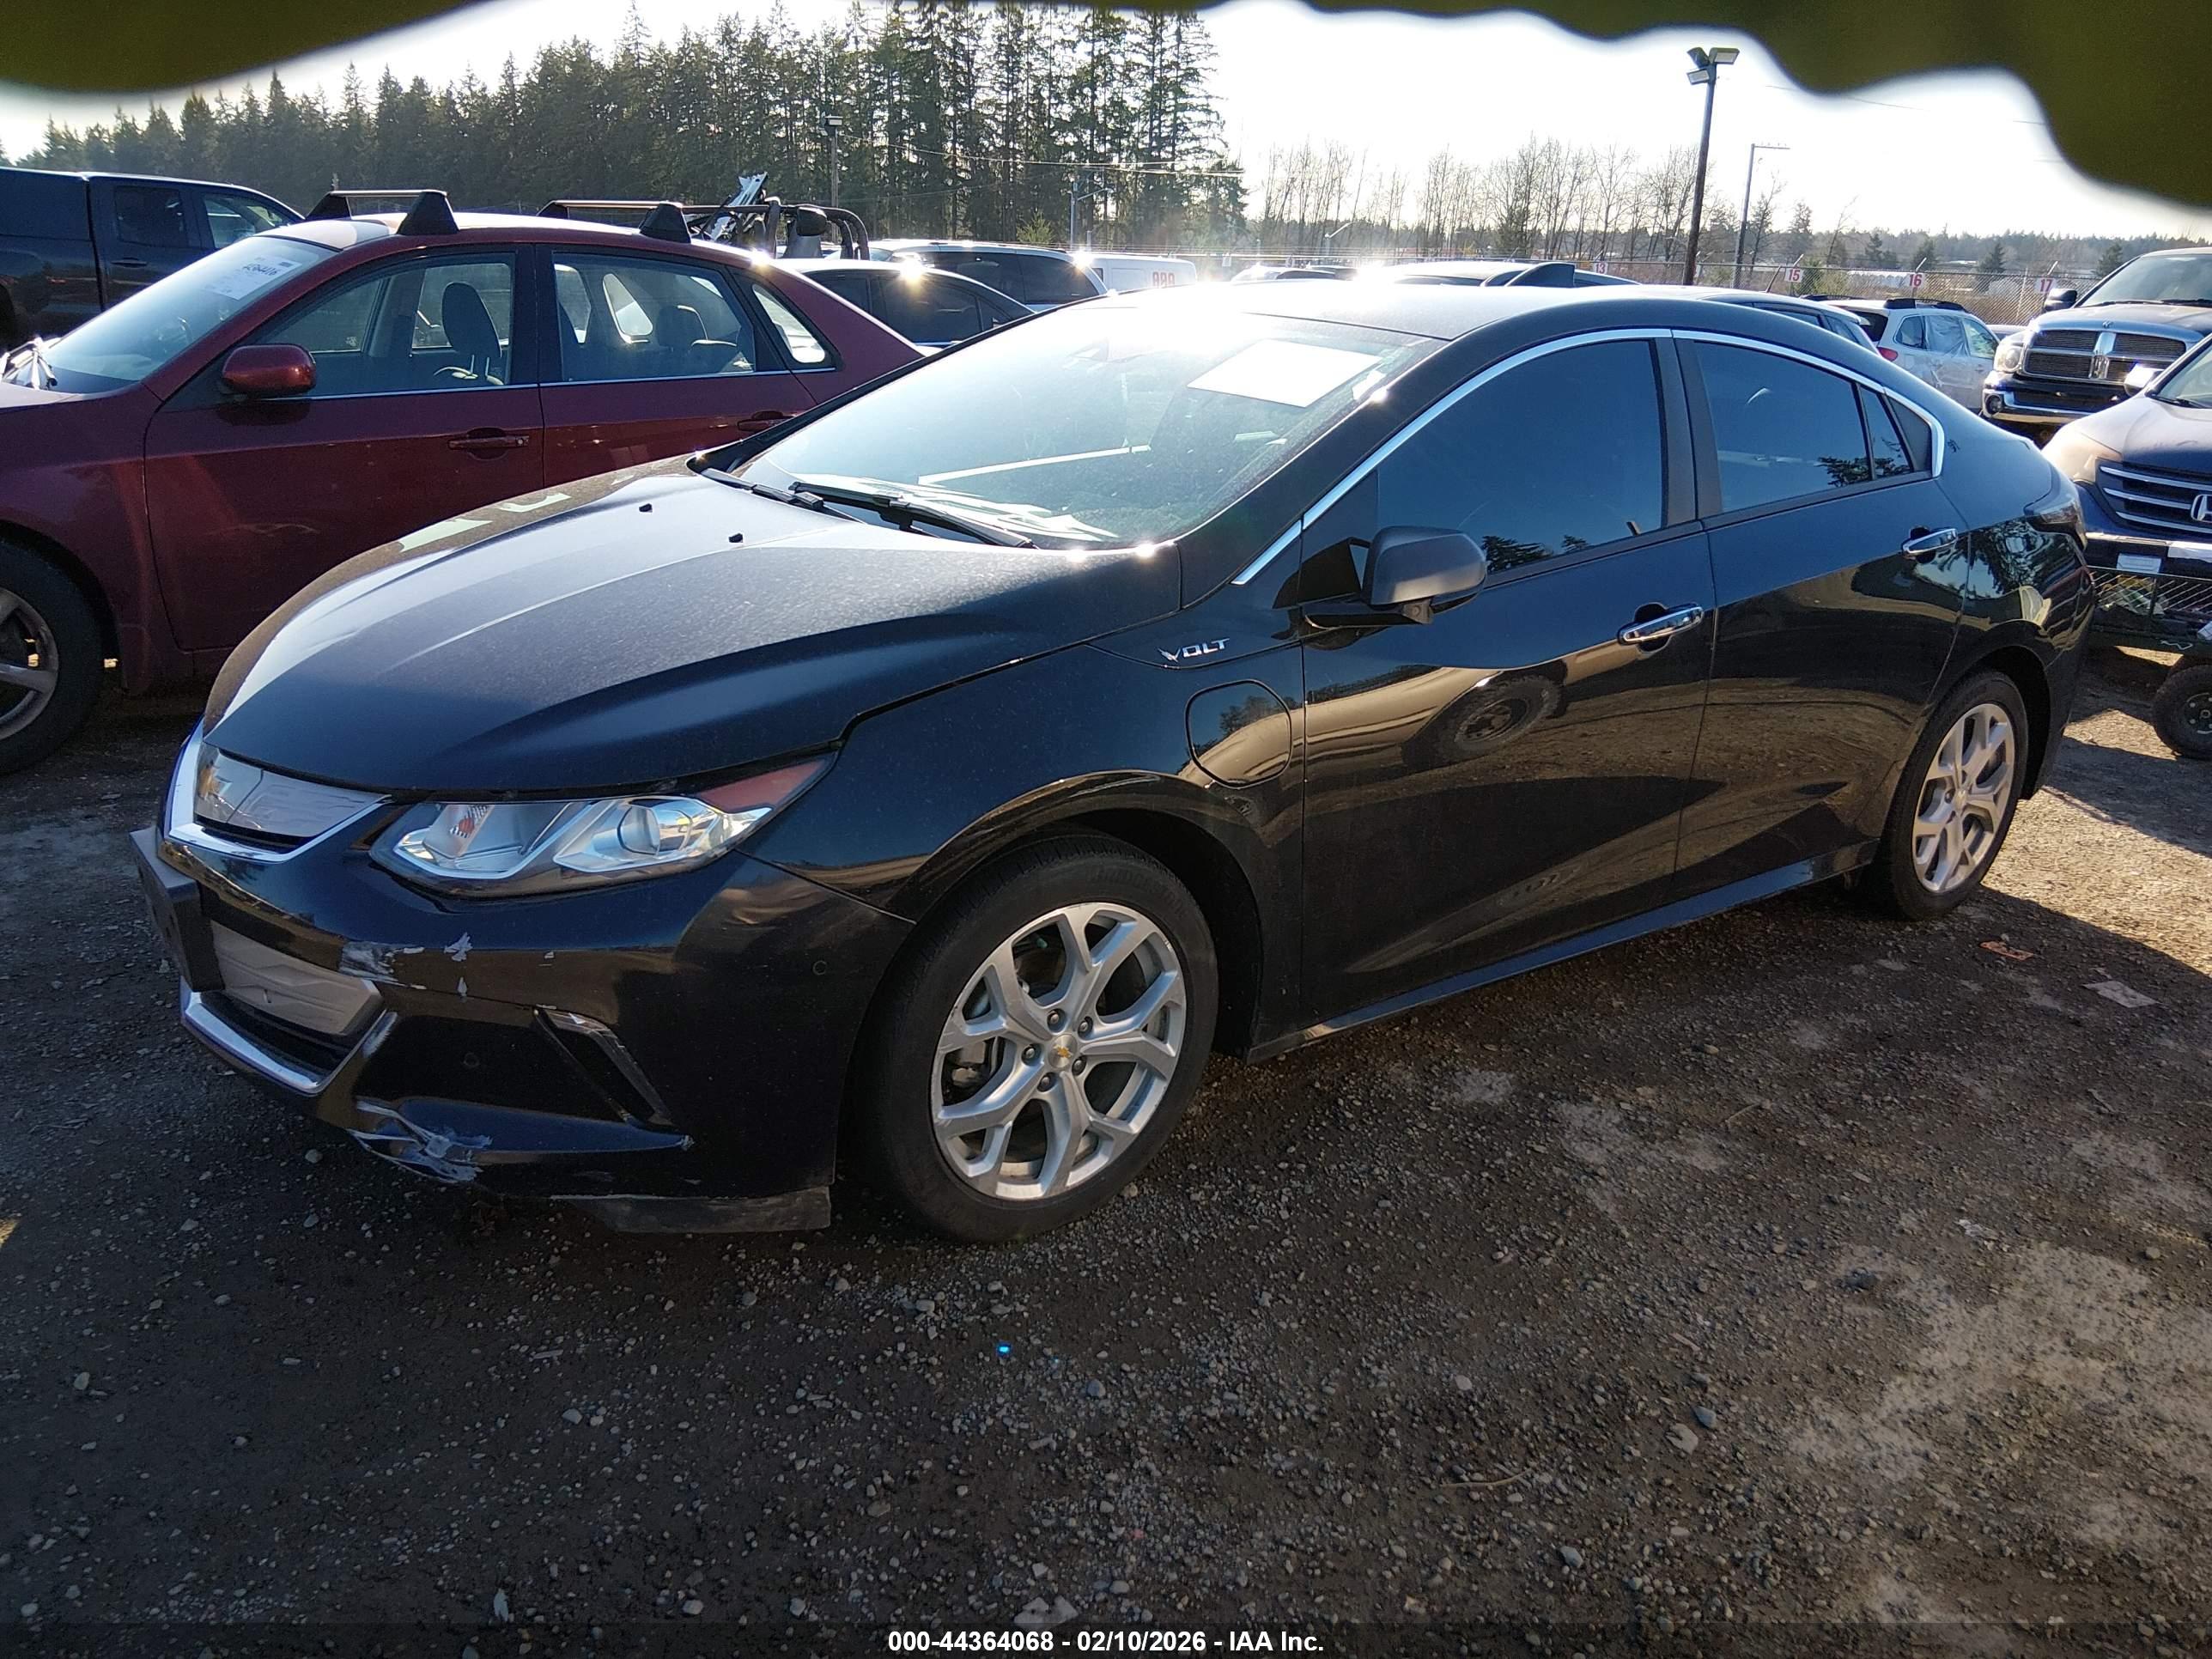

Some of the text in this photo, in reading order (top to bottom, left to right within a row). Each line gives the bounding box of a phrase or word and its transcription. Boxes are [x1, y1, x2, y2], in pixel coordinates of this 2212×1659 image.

[1789, 268, 1801, 282] 15
[1909, 273, 1923, 288] 16
[2040, 278, 2053, 293] 17
[1157, 637, 1231, 662] VOLT
